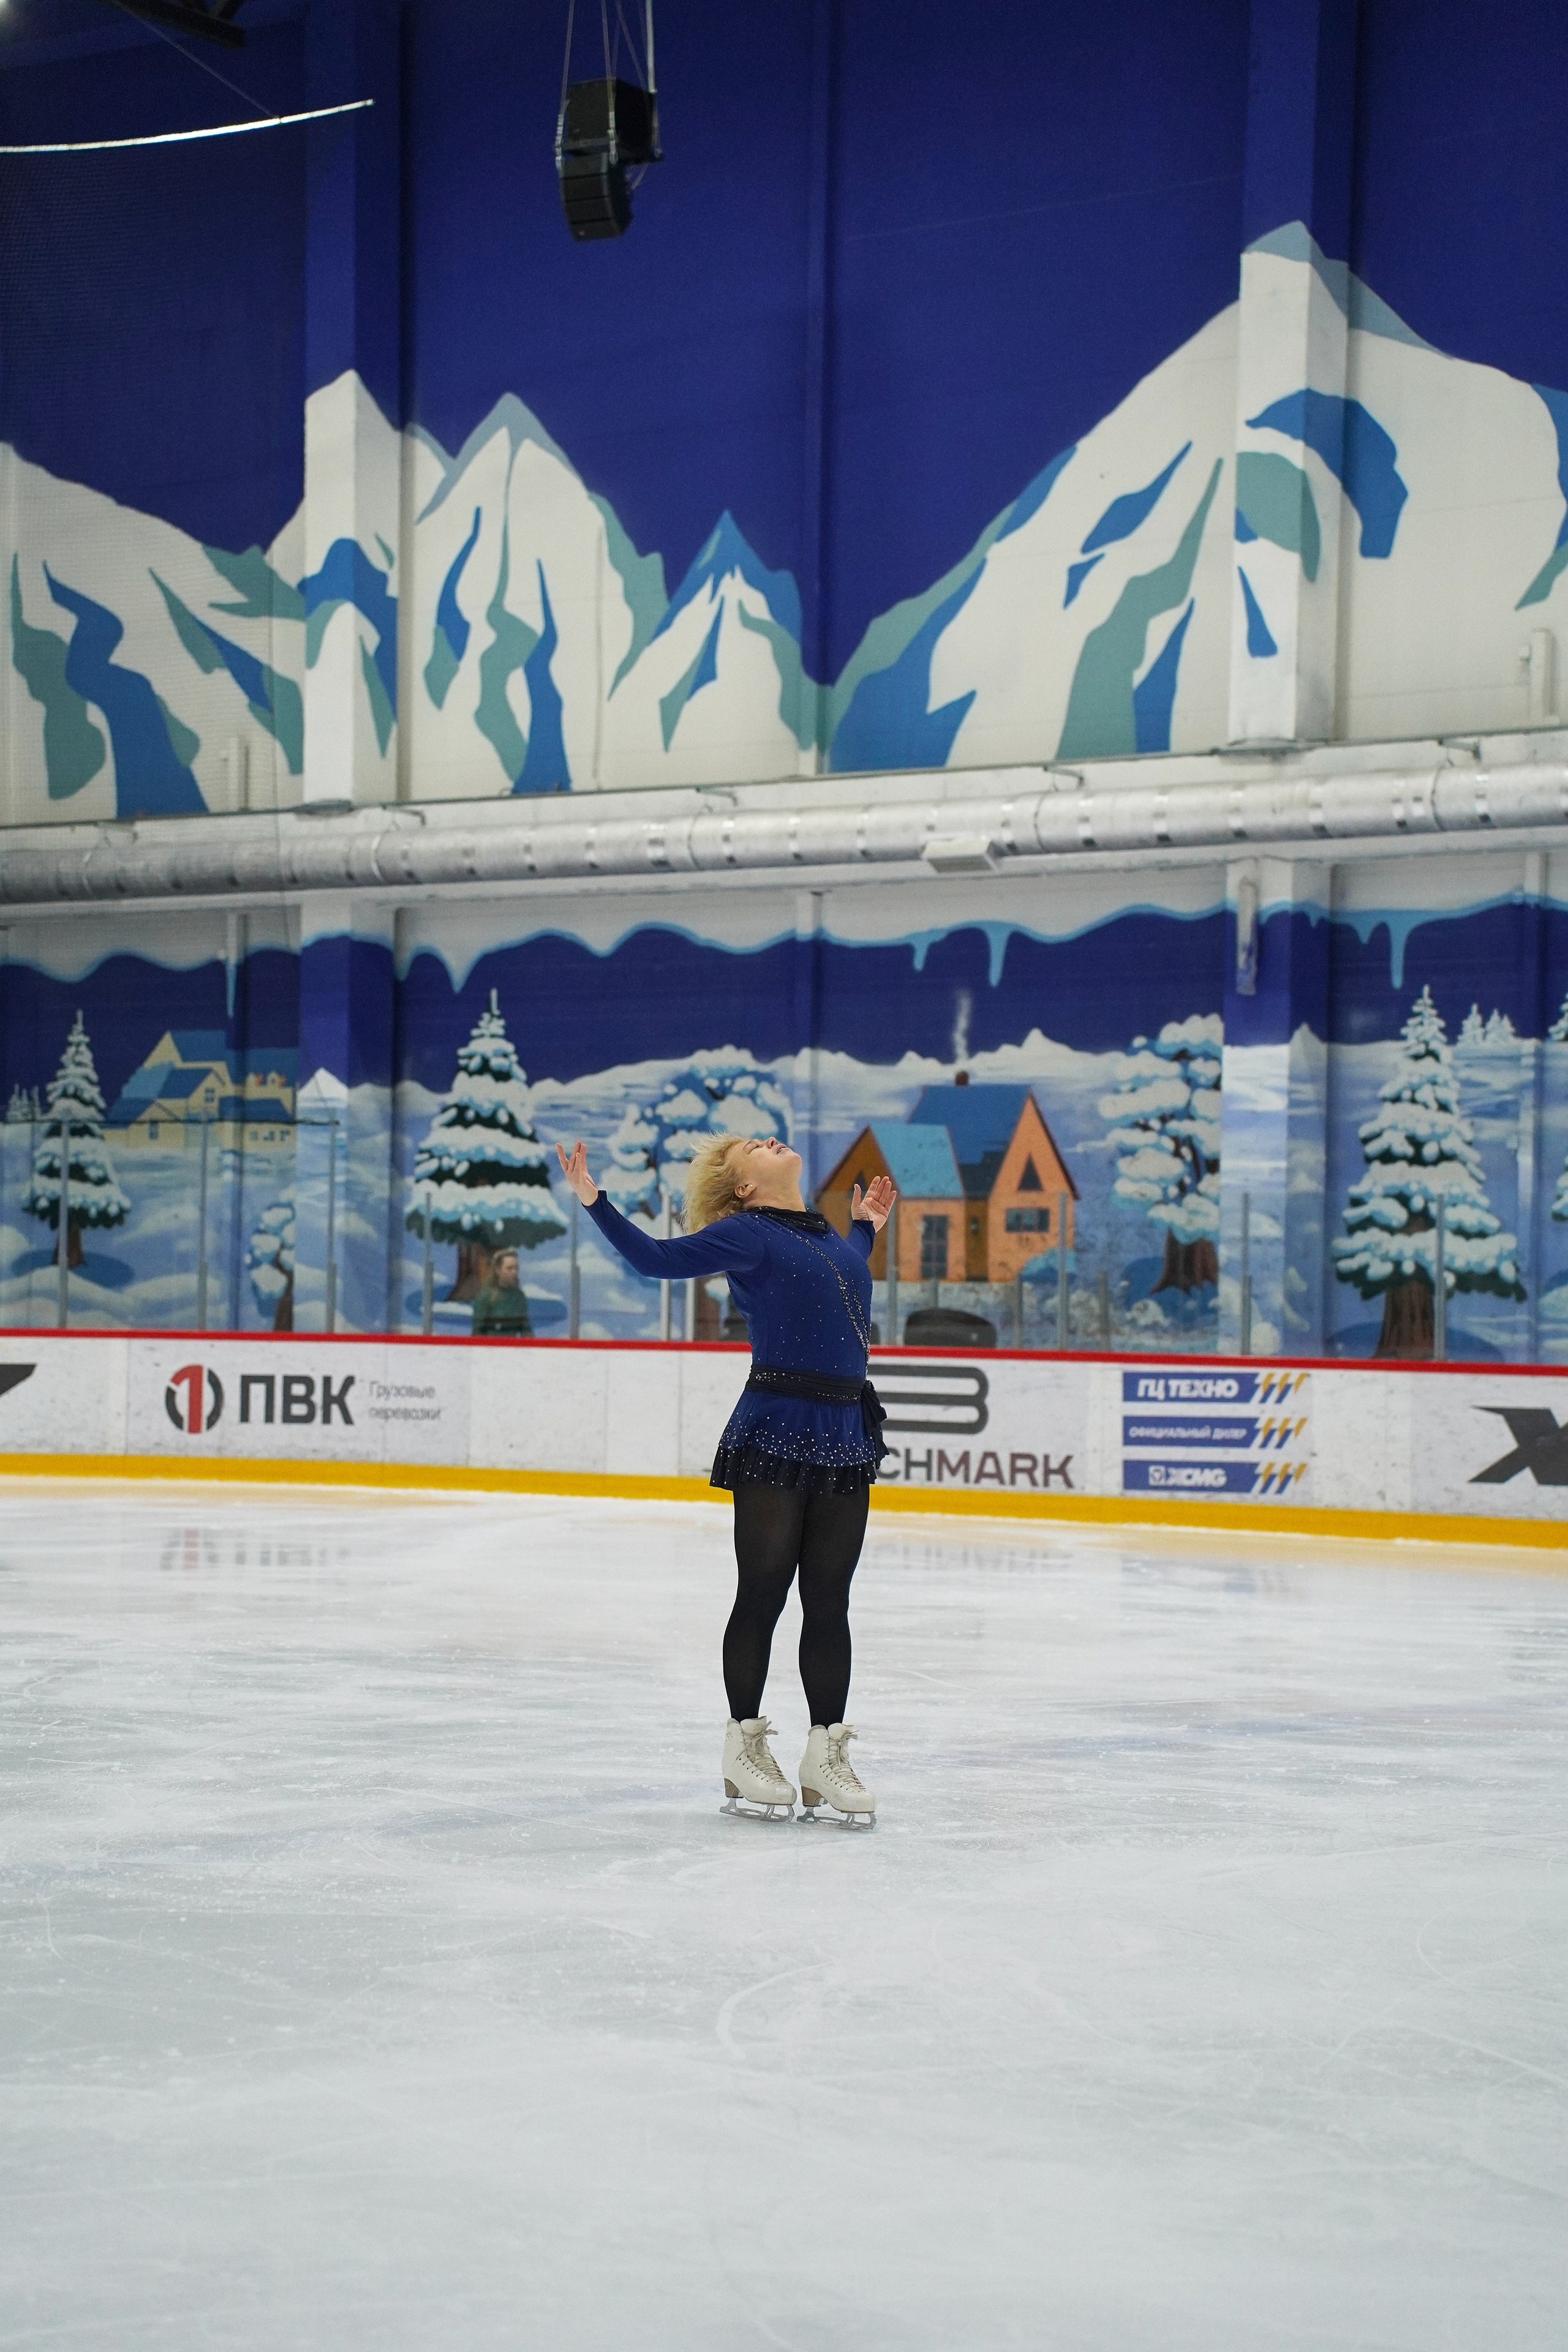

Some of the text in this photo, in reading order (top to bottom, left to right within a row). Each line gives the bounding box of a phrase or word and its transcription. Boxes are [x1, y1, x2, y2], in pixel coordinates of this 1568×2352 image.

[239, 1374, 356, 1425] ПВК
[369, 1381, 435, 1400] Грузовые
[1137, 1379, 1239, 1401] ГЦ ТЕХНО
[369, 1407, 440, 1422] перевозки
[876, 1446, 1074, 1489] CHMARK
